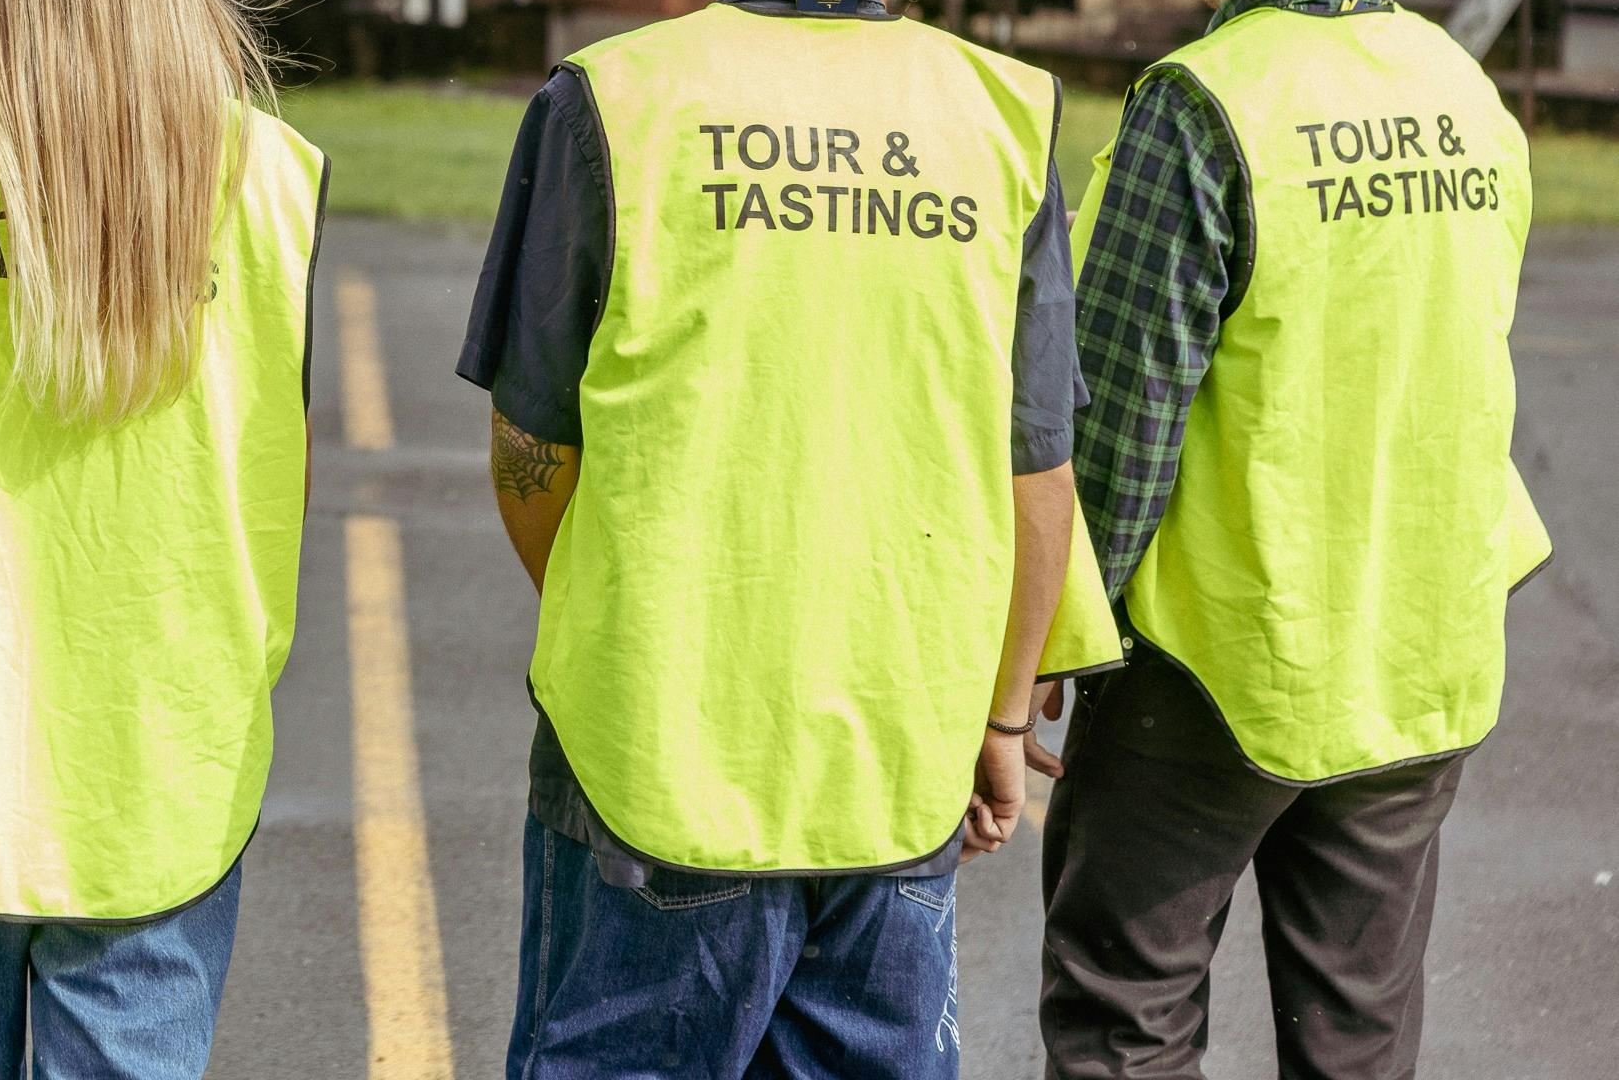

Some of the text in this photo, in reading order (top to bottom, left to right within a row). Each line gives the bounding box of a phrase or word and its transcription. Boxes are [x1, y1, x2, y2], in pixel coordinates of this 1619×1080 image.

[699, 124, 920, 178] TOUR &
[1295, 114, 1466, 167] TOUR &
[701, 183, 978, 243] TASTINGS
[1306, 167, 1499, 223] TASTINGS
